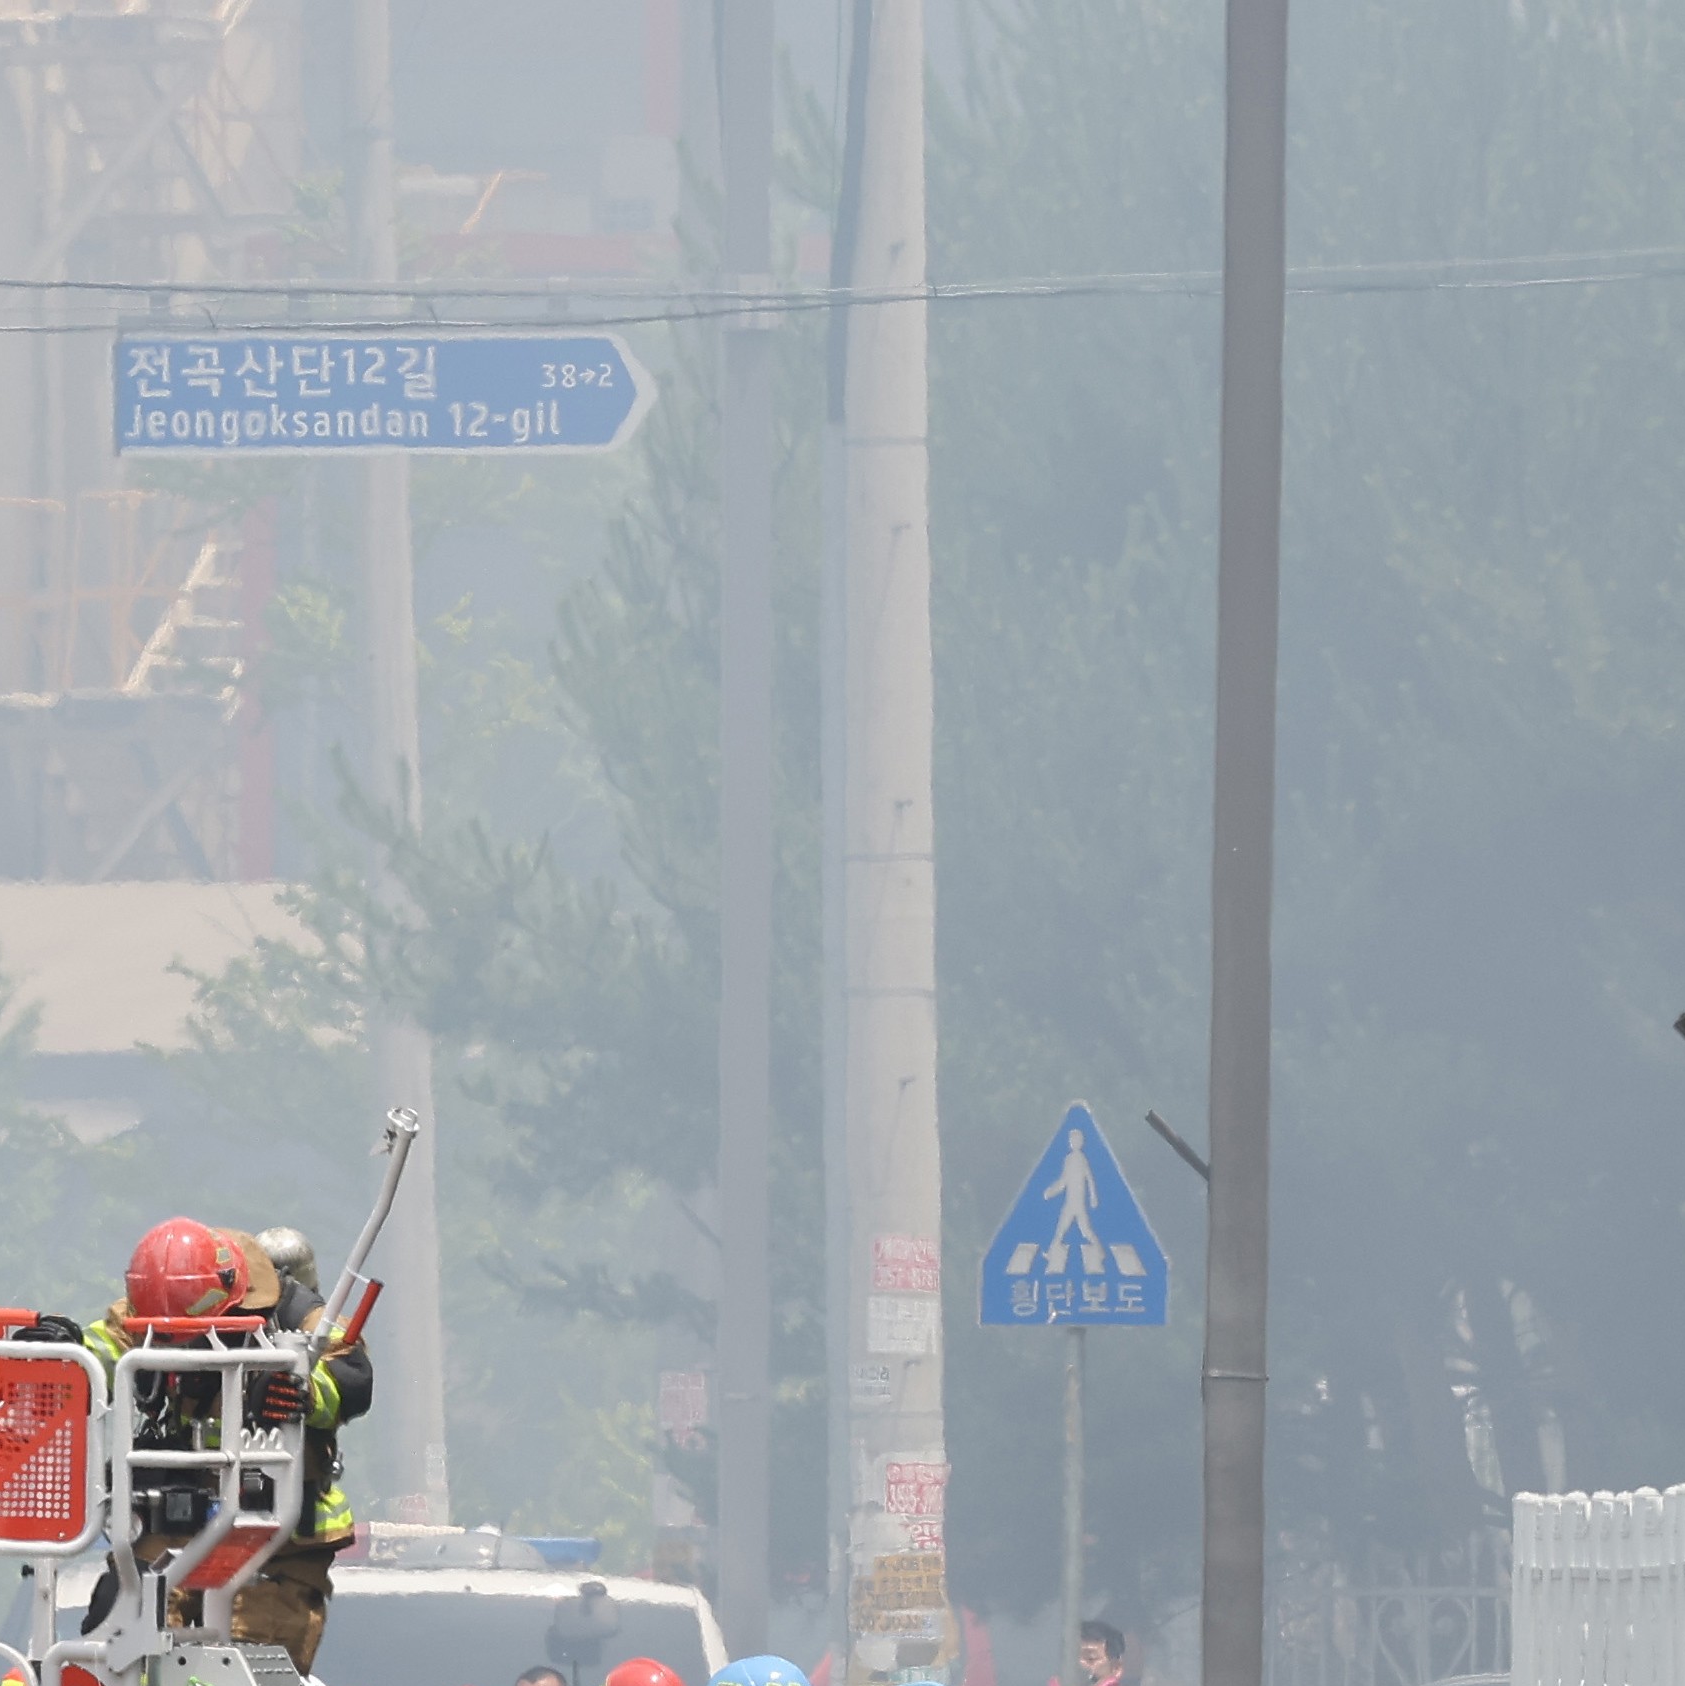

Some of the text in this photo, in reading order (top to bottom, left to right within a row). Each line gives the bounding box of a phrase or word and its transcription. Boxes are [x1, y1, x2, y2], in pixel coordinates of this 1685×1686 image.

[127, 345, 438, 399] 전곡산단12길
[124, 402, 561, 445] Jeongoksandan 12-gil
